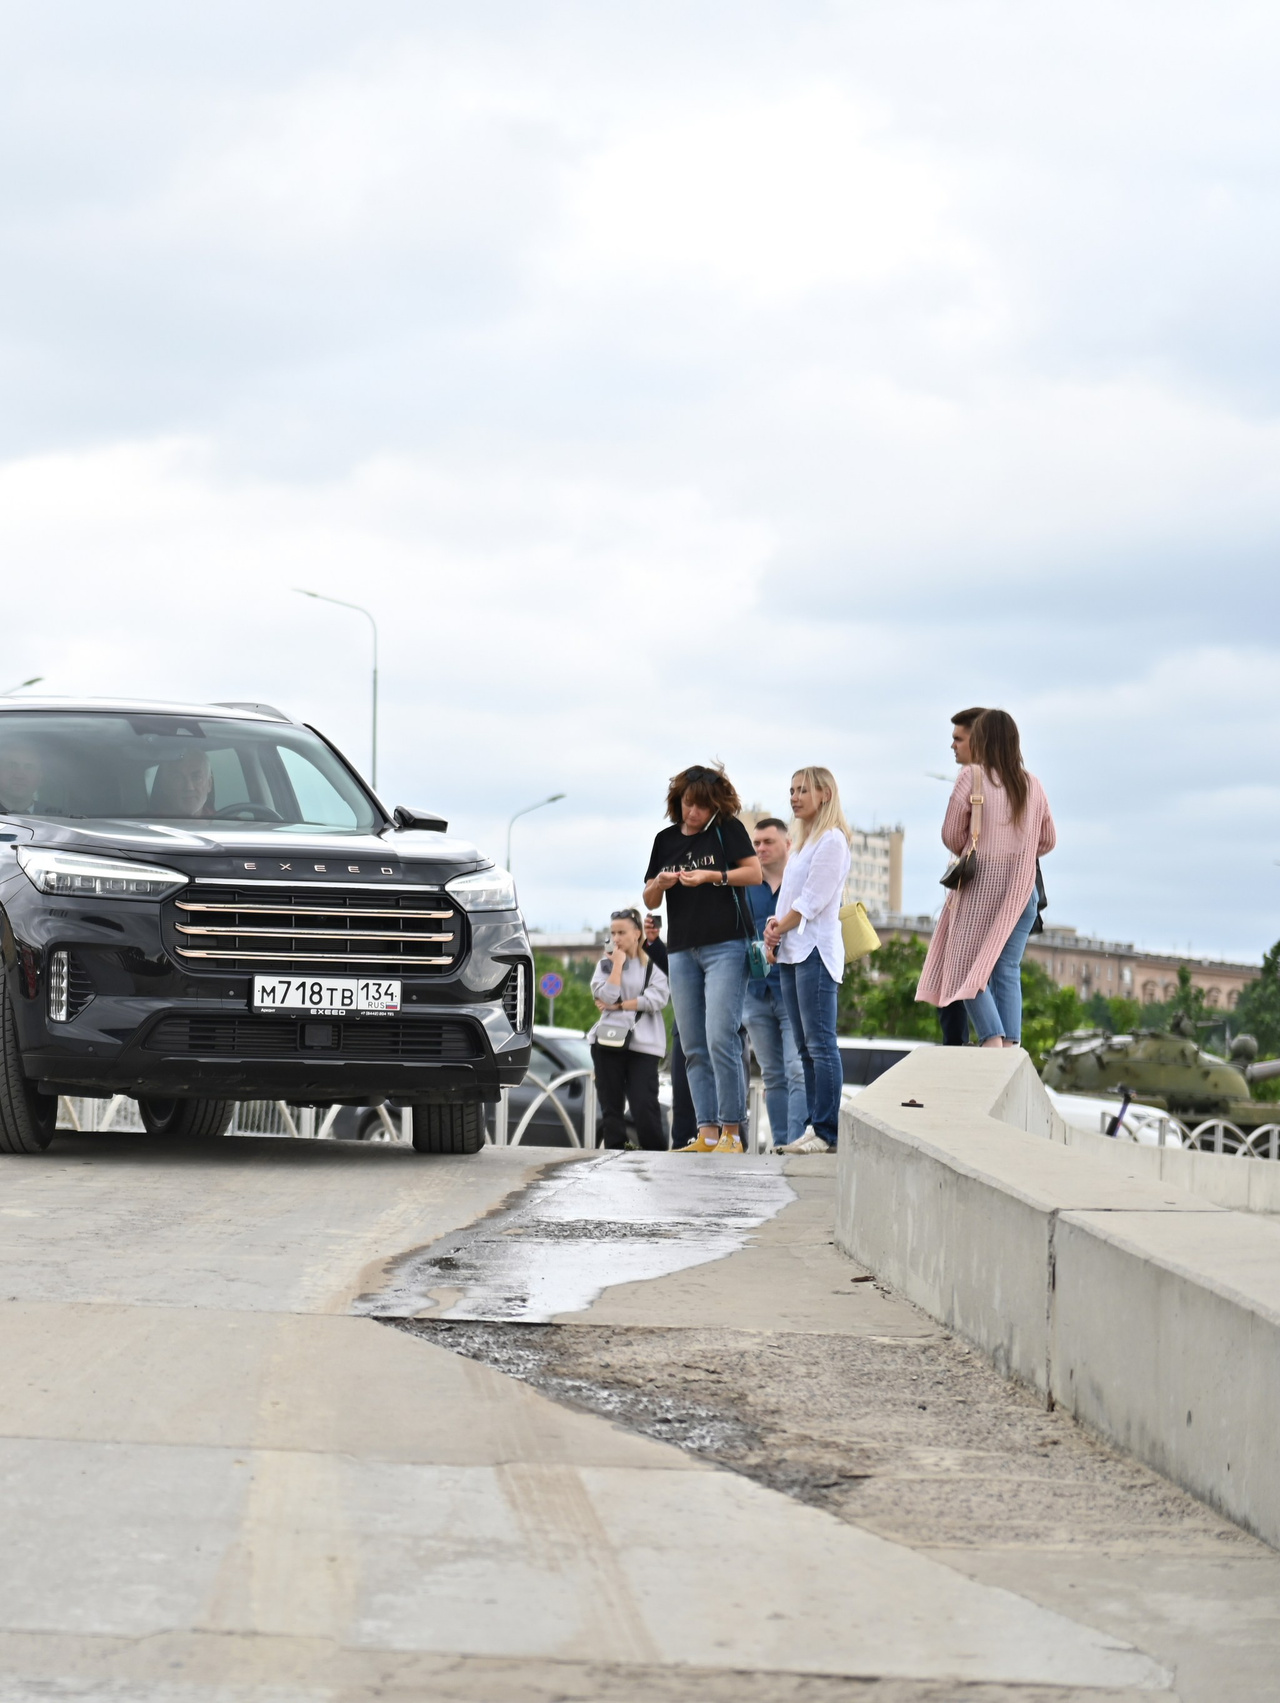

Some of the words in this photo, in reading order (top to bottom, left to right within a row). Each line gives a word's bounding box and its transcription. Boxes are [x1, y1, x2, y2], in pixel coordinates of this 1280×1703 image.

[244, 862, 394, 875] EXEED
[361, 982, 394, 1001] 134
[367, 1001, 385, 1009] RUS
[310, 1008, 346, 1016] EXEED
